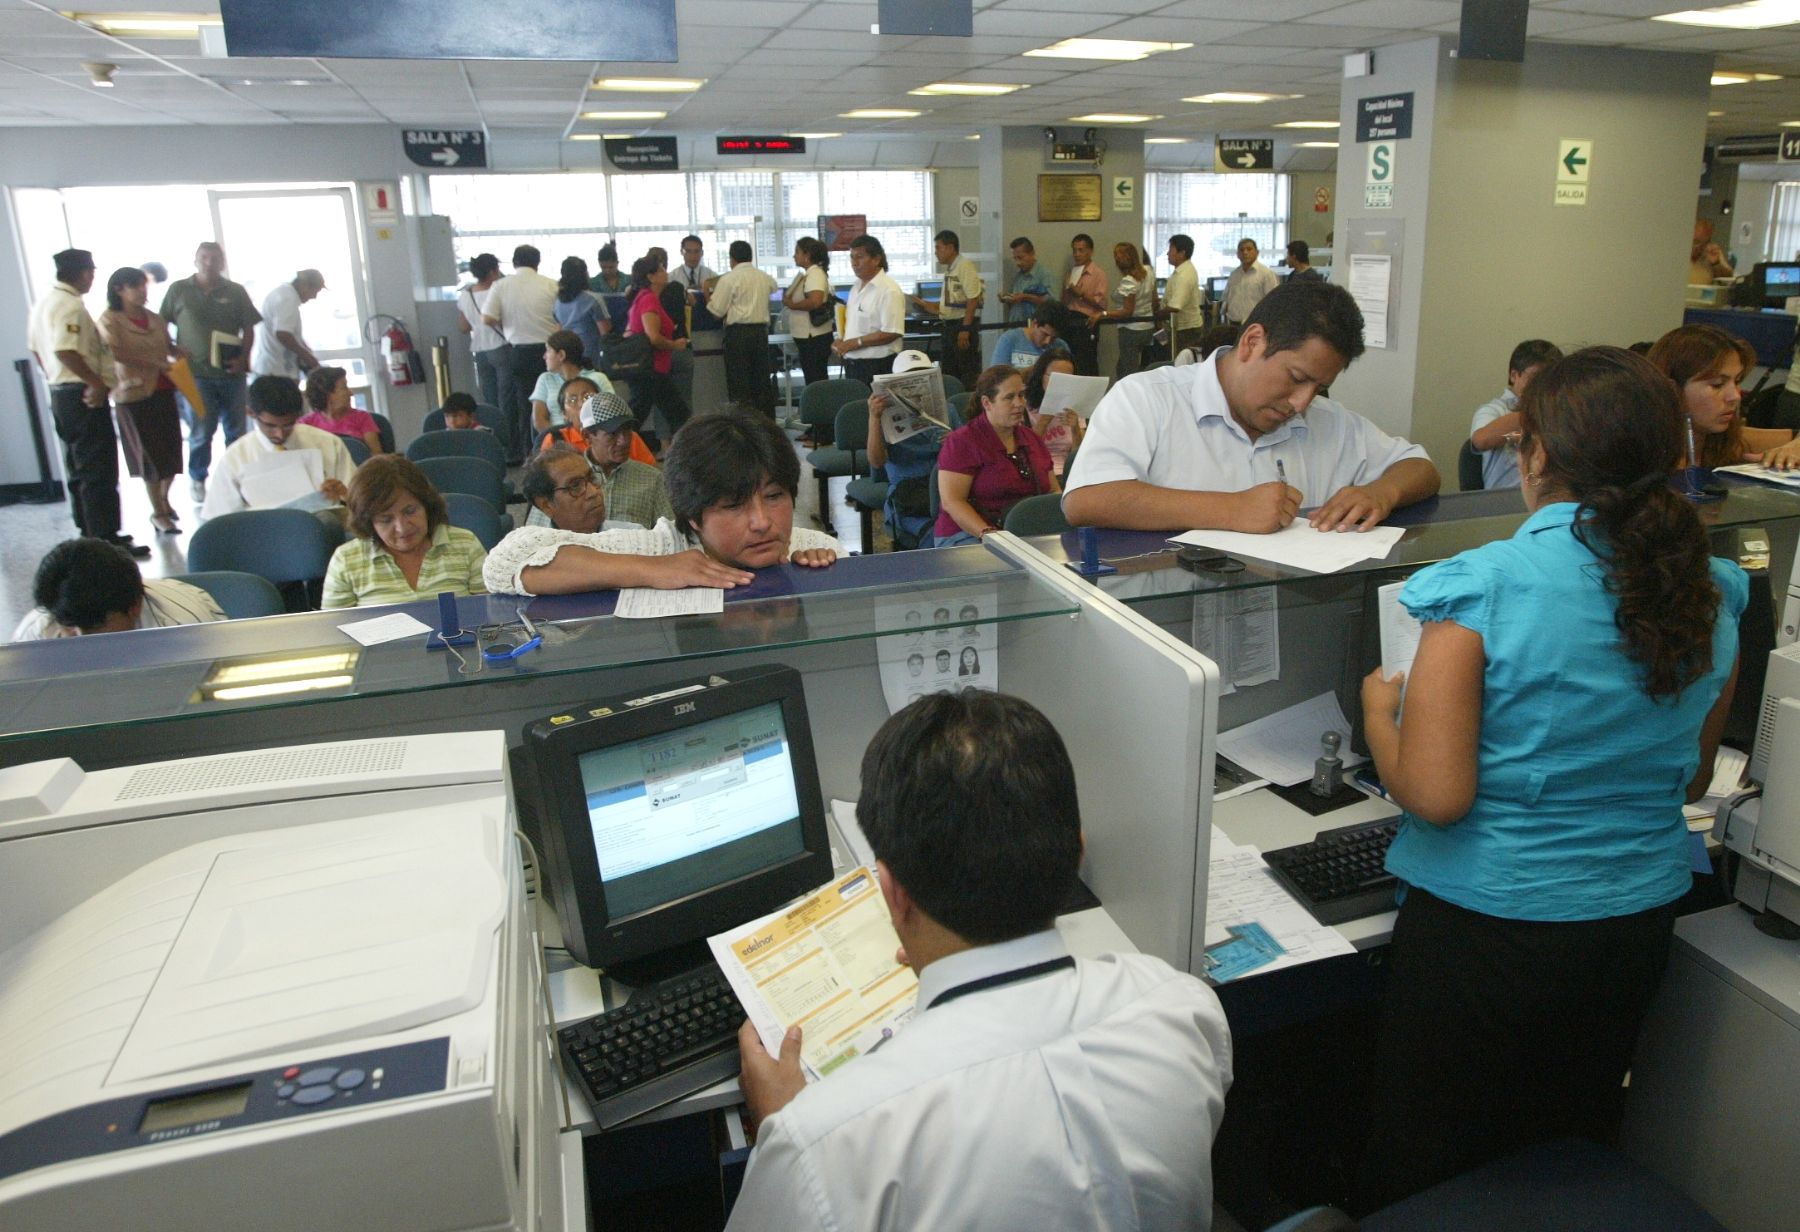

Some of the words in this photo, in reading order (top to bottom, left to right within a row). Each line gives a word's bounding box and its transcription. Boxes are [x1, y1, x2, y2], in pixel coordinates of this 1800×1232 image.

[407, 131, 447, 144] SALA
[472, 131, 480, 144] 3
[1223, 141, 1249, 150] SALA
[1265, 141, 1271, 150] 3
[1372, 145, 1389, 180] S
[1557, 190, 1585, 199] SALIDA
[673, 701, 696, 716] IBM
